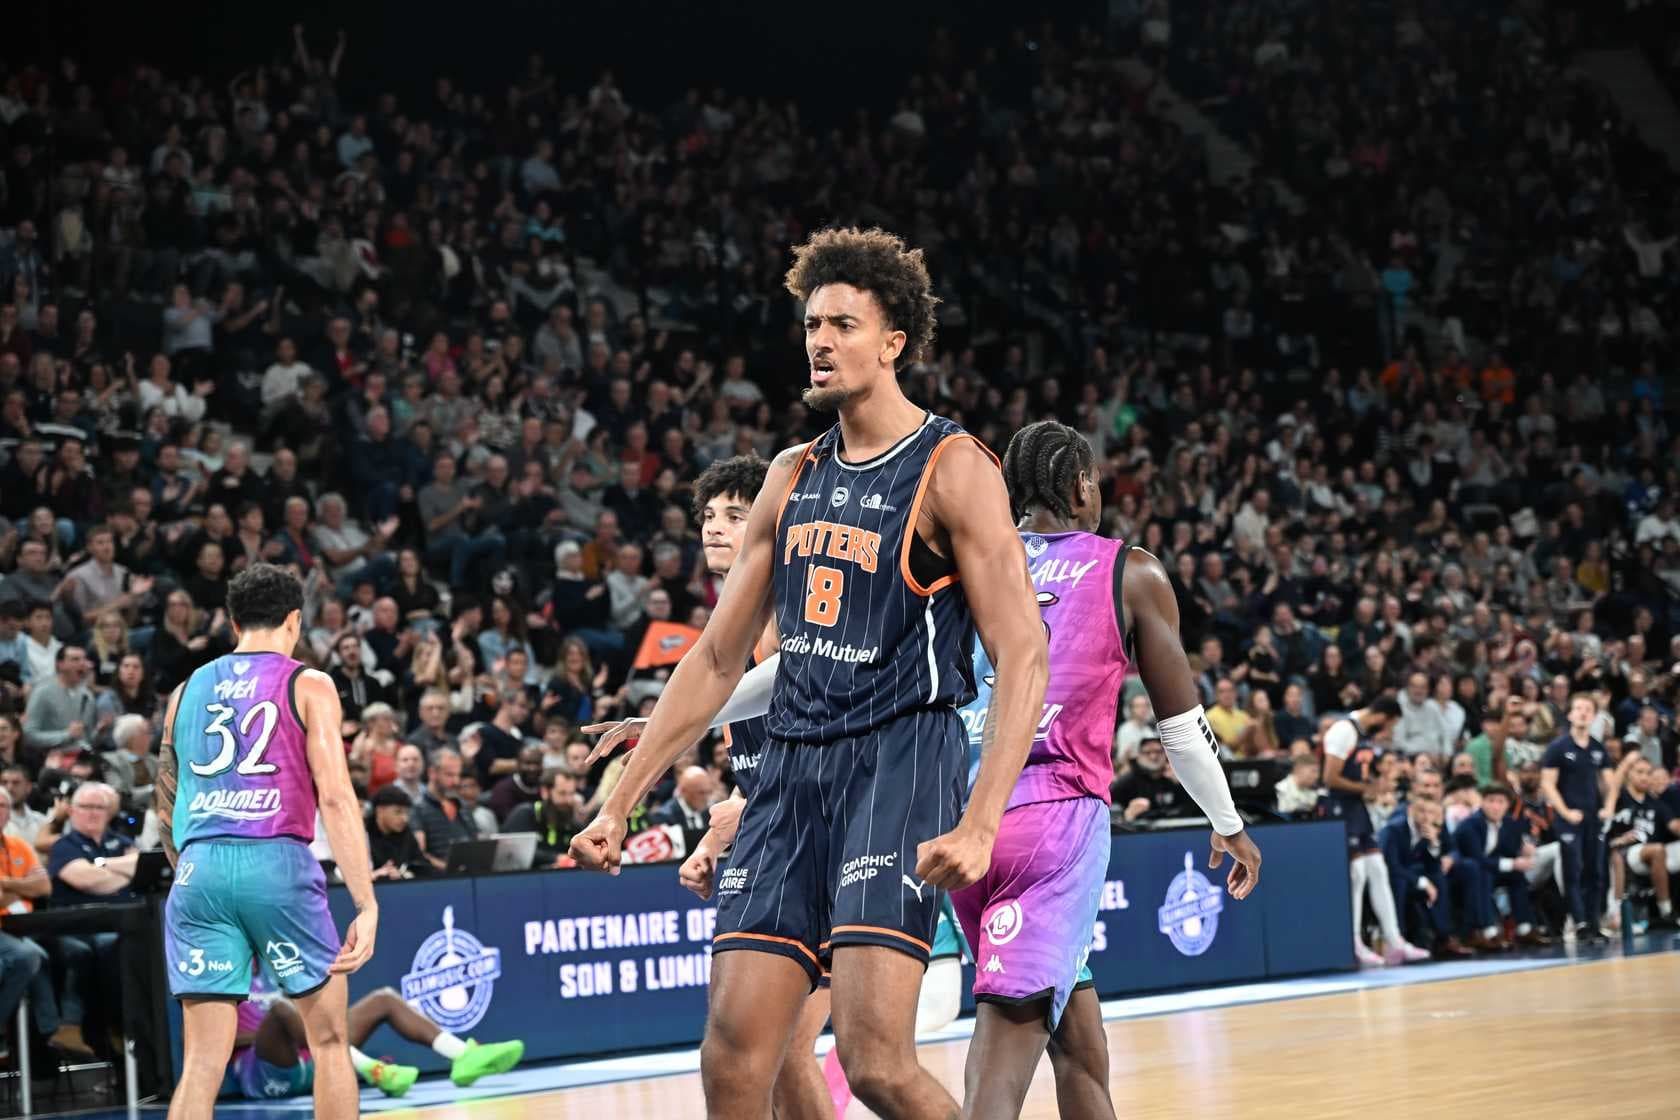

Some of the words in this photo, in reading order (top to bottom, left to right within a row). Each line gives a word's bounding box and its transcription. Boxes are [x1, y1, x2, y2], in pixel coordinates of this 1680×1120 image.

[1030, 559, 1098, 588] ALLY
[812, 637, 878, 664] Mutuel
[189, 700, 280, 777] 32
[841, 868, 878, 887] GROUP
[842, 854, 895, 875] GRAPHIC
[524, 910, 681, 956] PARTENAIRE
[559, 961, 614, 999] SON
[619, 959, 639, 993] &
